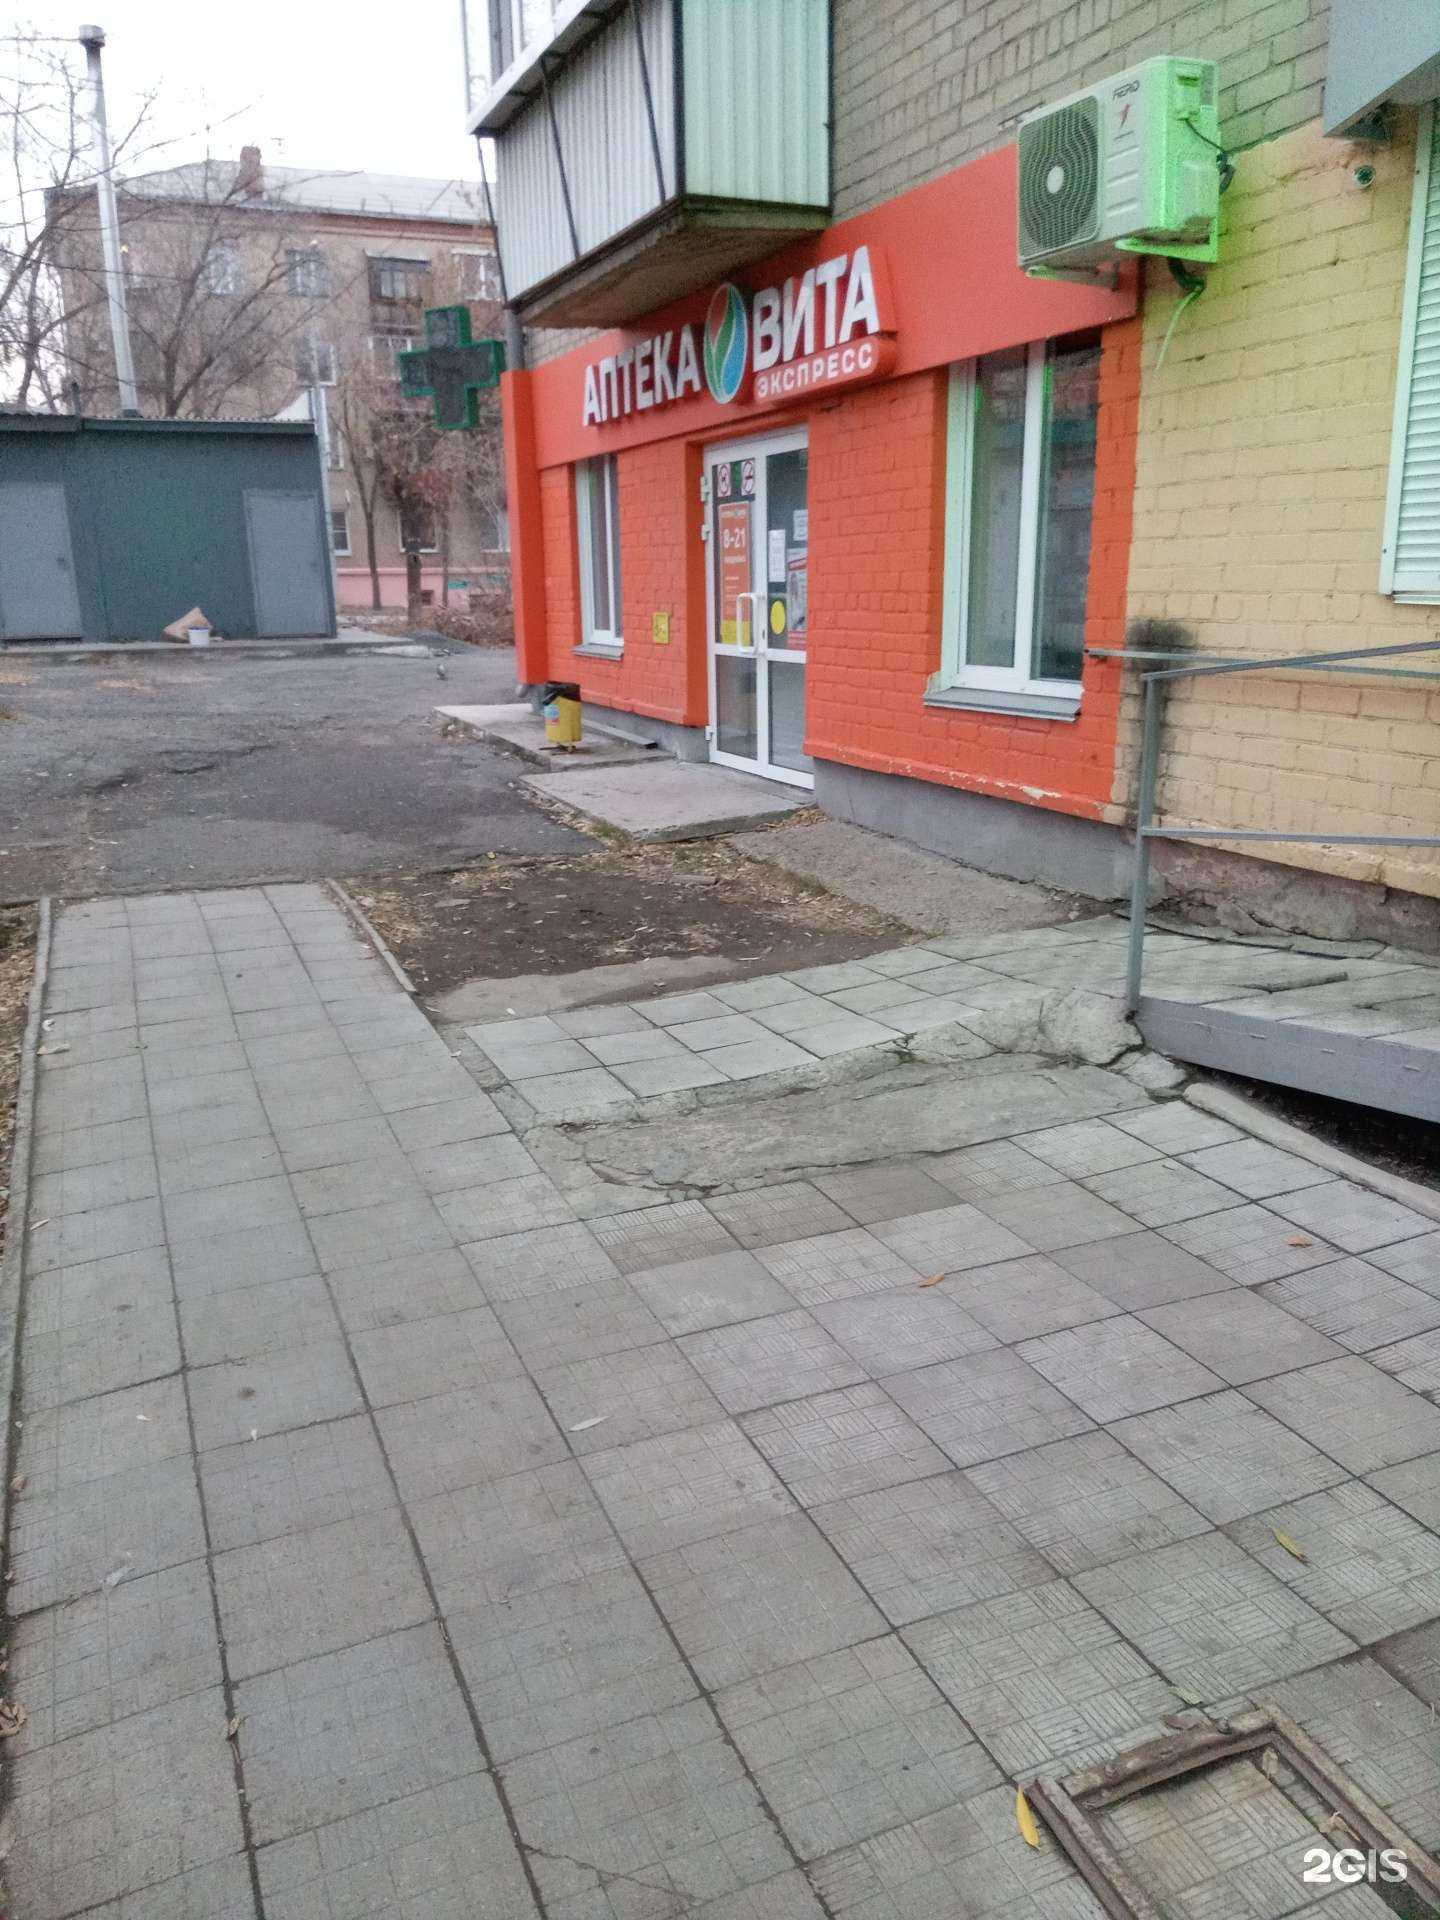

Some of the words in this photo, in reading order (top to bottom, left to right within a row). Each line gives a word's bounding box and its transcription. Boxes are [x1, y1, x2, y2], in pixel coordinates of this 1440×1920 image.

[583, 324, 701, 426] АПТЕКА
[753, 246, 880, 372] ВИТА
[757, 343, 873, 398] ЭКСПРЕСС
